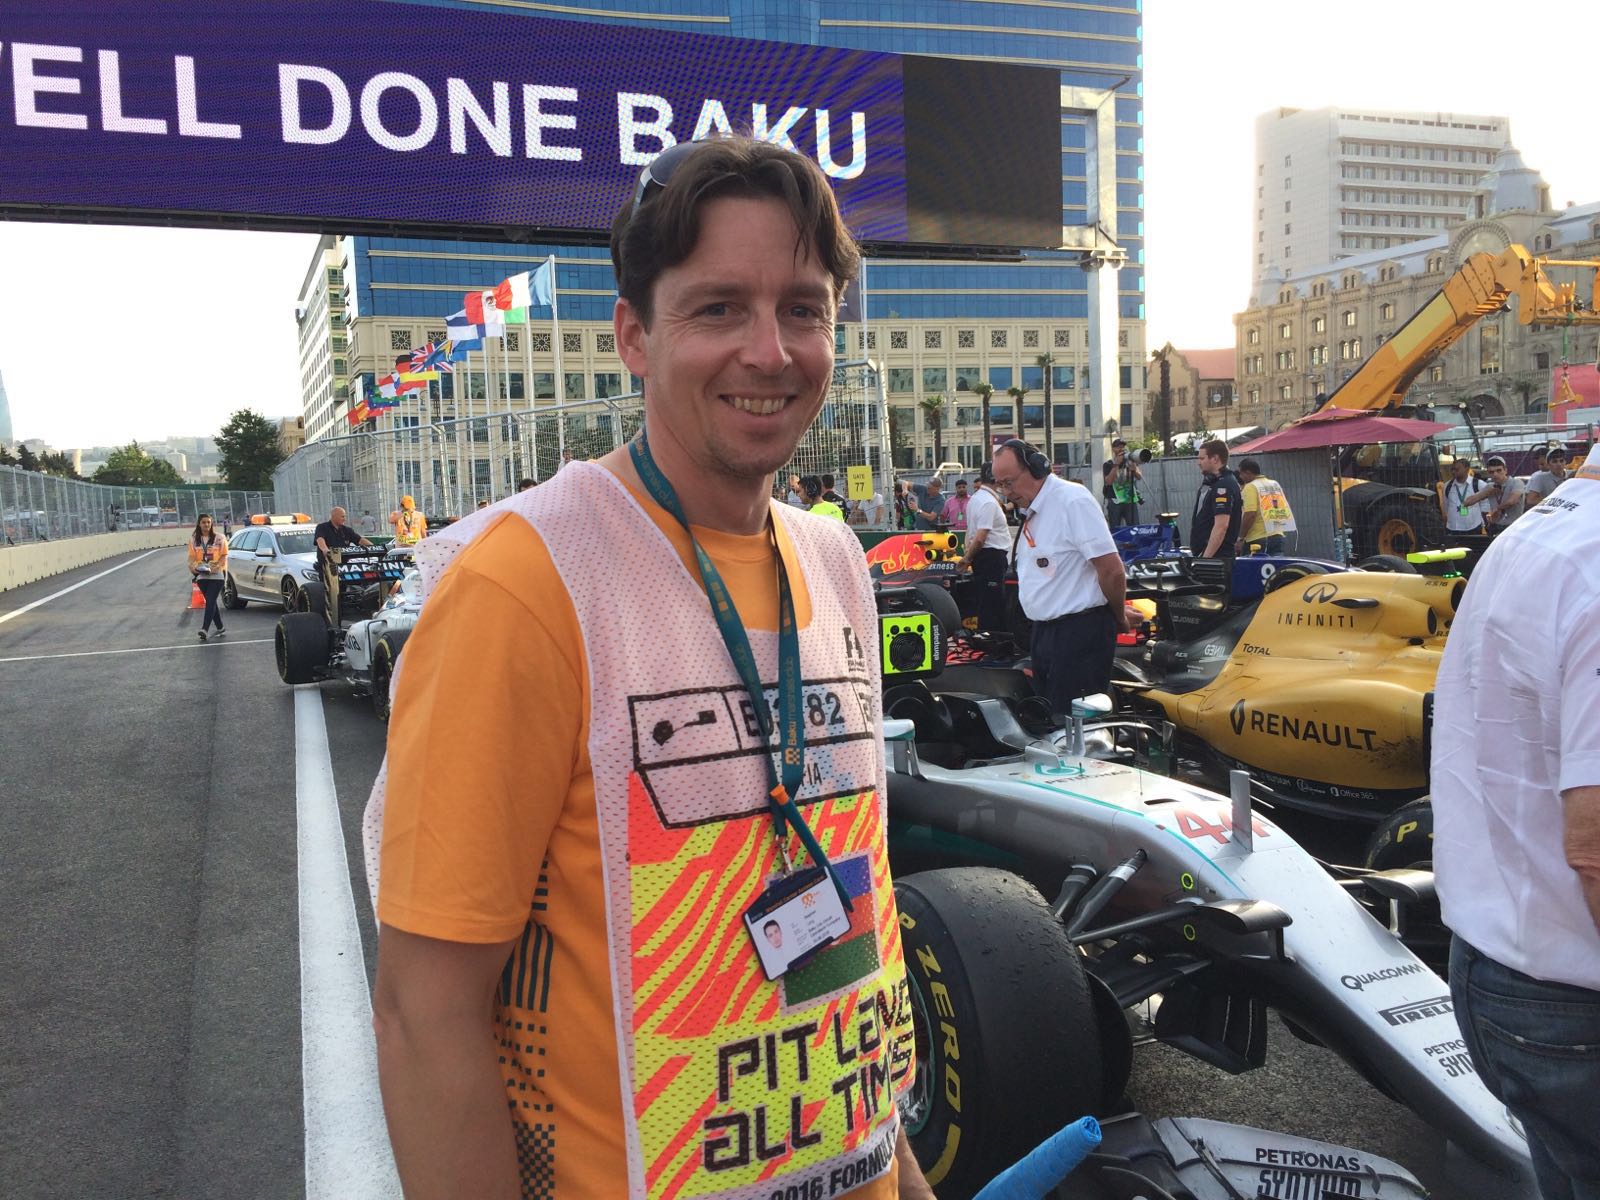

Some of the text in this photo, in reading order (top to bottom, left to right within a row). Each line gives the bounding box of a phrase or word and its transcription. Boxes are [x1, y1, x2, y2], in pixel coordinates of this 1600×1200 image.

[0, 41, 867, 180] ELL DONE BAKU
[855, 482, 865, 492] 77
[338, 562, 405, 573] MARINI
[1125, 561, 1182, 579] AULT
[1278, 612, 1354, 628] INFINITI
[1242, 643, 1271, 656] TOTAL
[1251, 709, 1377, 751] RENAULT
[1341, 963, 1426, 991] QUALCOMM
[1378, 995, 1455, 1027] PIRELL
[916, 944, 962, 1113] ZERO
[1423, 1039, 1467, 1057] PETRO
[718, 1020, 819, 1104] PIT
[1438, 1051, 1473, 1078] SYN
[829, 1124, 898, 1196] FORMUL
[1255, 1147, 1361, 1172] PETRONAS
